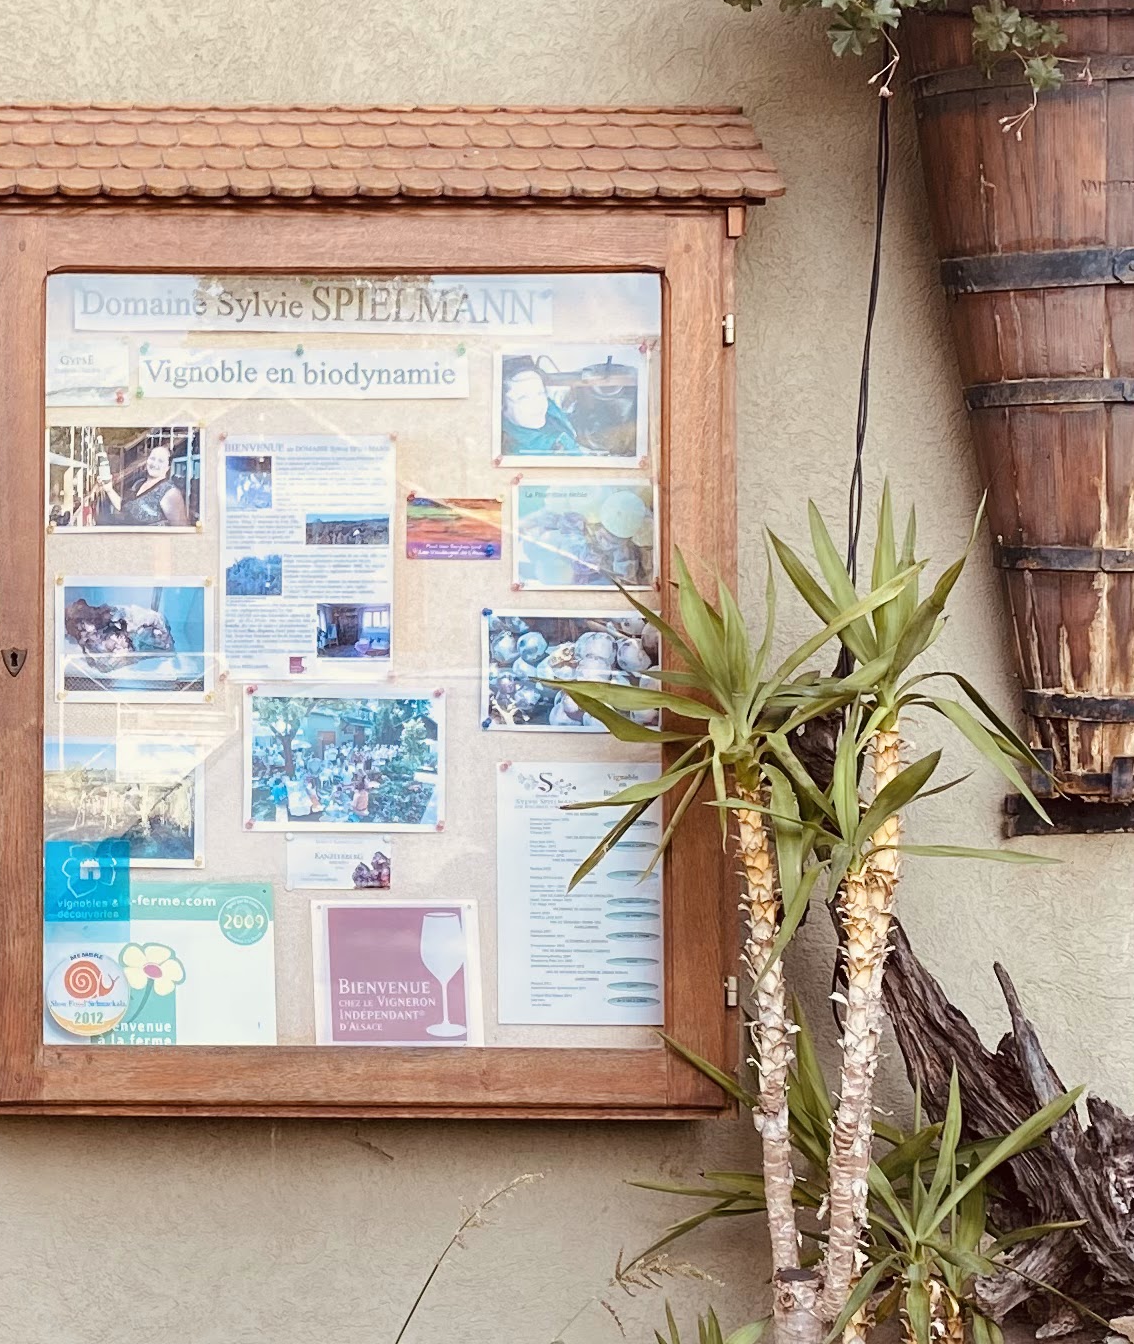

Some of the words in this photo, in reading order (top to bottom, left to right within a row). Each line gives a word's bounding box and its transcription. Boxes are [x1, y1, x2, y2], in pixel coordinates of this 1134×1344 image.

[80, 289, 208, 316] Domaine
[217, 290, 304, 323] Sylvie
[312, 285, 538, 325] SPIELMANN
[144, 359, 258, 389] Vignoble
[266, 367, 296, 384] en
[302, 361, 456, 391] biodynamie
[224, 443, 284, 452] BIENVENUE
[57, 899, 107, 910] vignobles
[112, 899, 119, 907] &
[223, 914, 264, 929] 2009
[338, 978, 431, 995] BIENVENUE
[338, 999, 361, 1007] CHEZ
[364, 999, 373, 1007] LE
[377, 995, 436, 1007] VIGNERON
[74, 1011, 104, 1024] 2012
[113, 1022, 172, 1032] envenue
[130, 1034, 172, 1045] ferme
